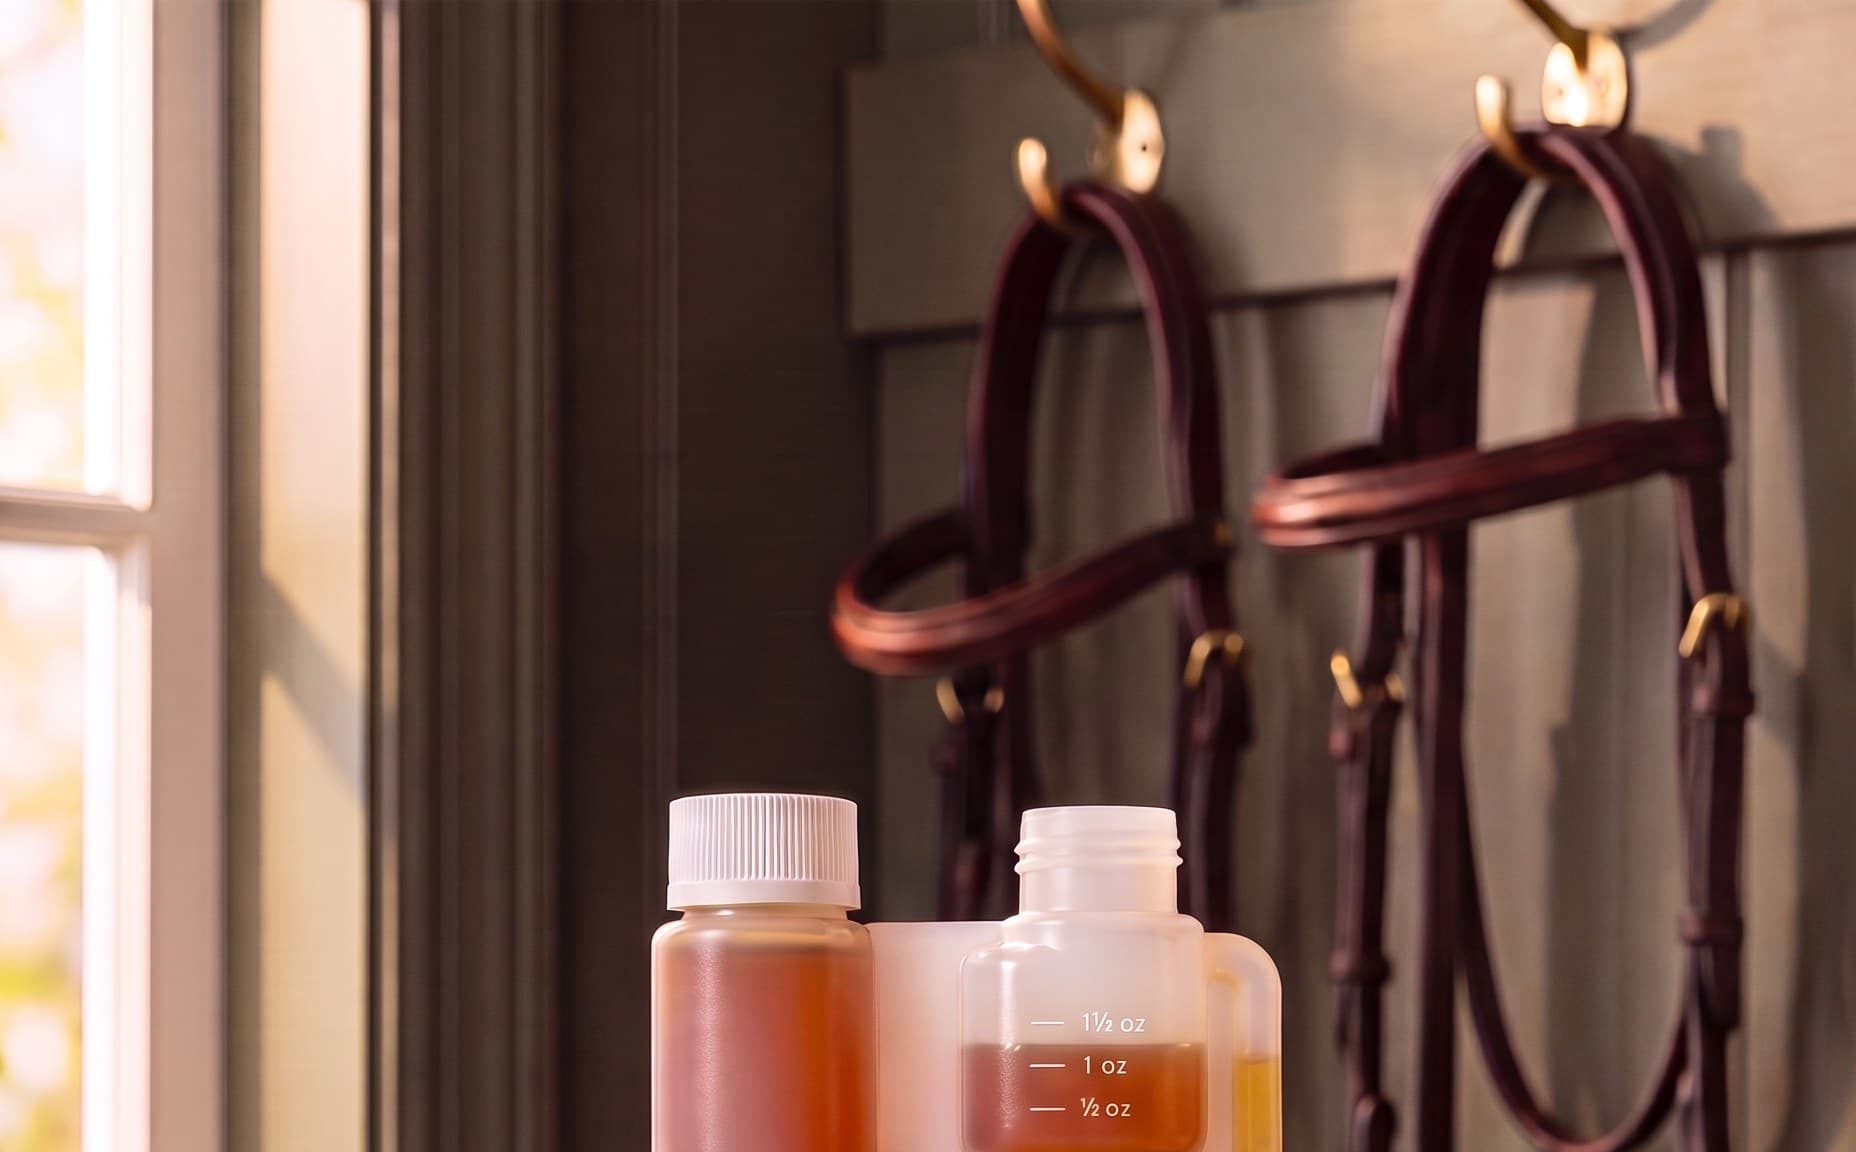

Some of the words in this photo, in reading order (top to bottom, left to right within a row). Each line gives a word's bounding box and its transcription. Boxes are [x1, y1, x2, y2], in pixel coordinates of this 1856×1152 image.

[1120, 1017, 1146, 1033] oz
[1083, 1055, 1091, 1075] 1
[1101, 1060, 1128, 1075] oz
[1105, 1103, 1131, 1117] oz
